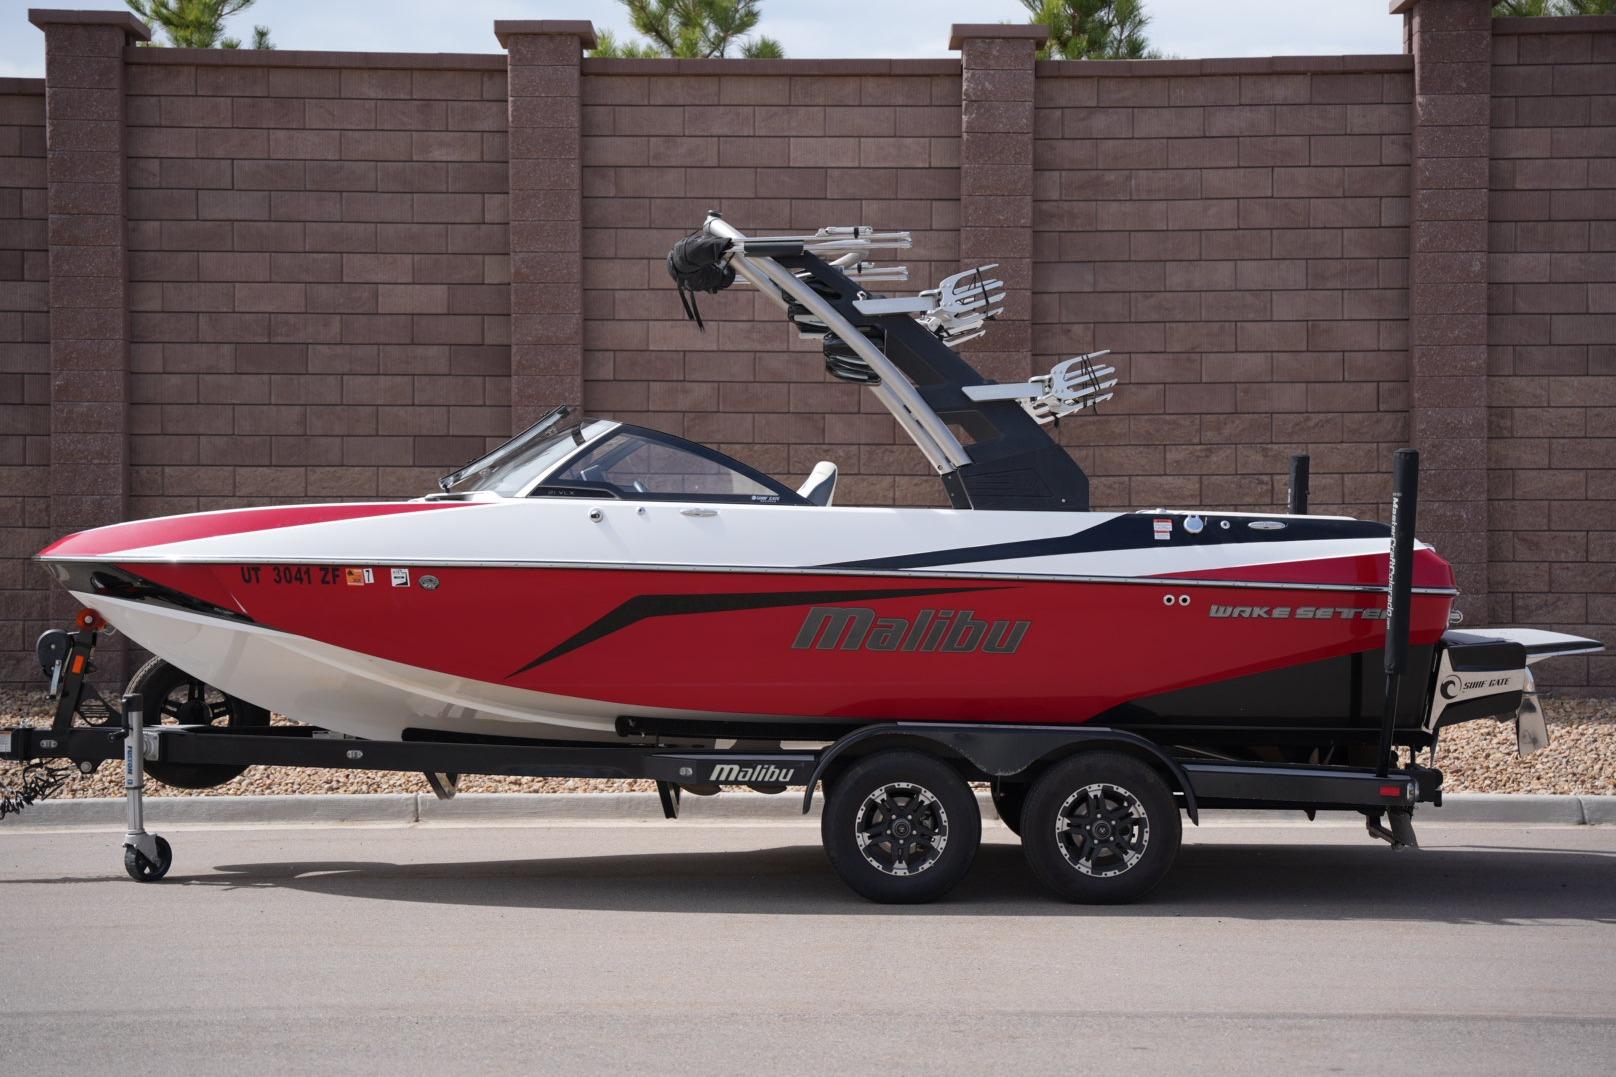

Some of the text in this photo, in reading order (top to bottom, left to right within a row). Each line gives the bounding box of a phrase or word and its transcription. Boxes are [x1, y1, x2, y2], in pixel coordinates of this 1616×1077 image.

[241, 565, 340, 585] UT 3041 ZF
[1209, 604, 1291, 619] WAKE
[790, 606, 1032, 654] Malibu
[1463, 677, 1512, 690] SURF GATE
[709, 764, 795, 782] Malibu
